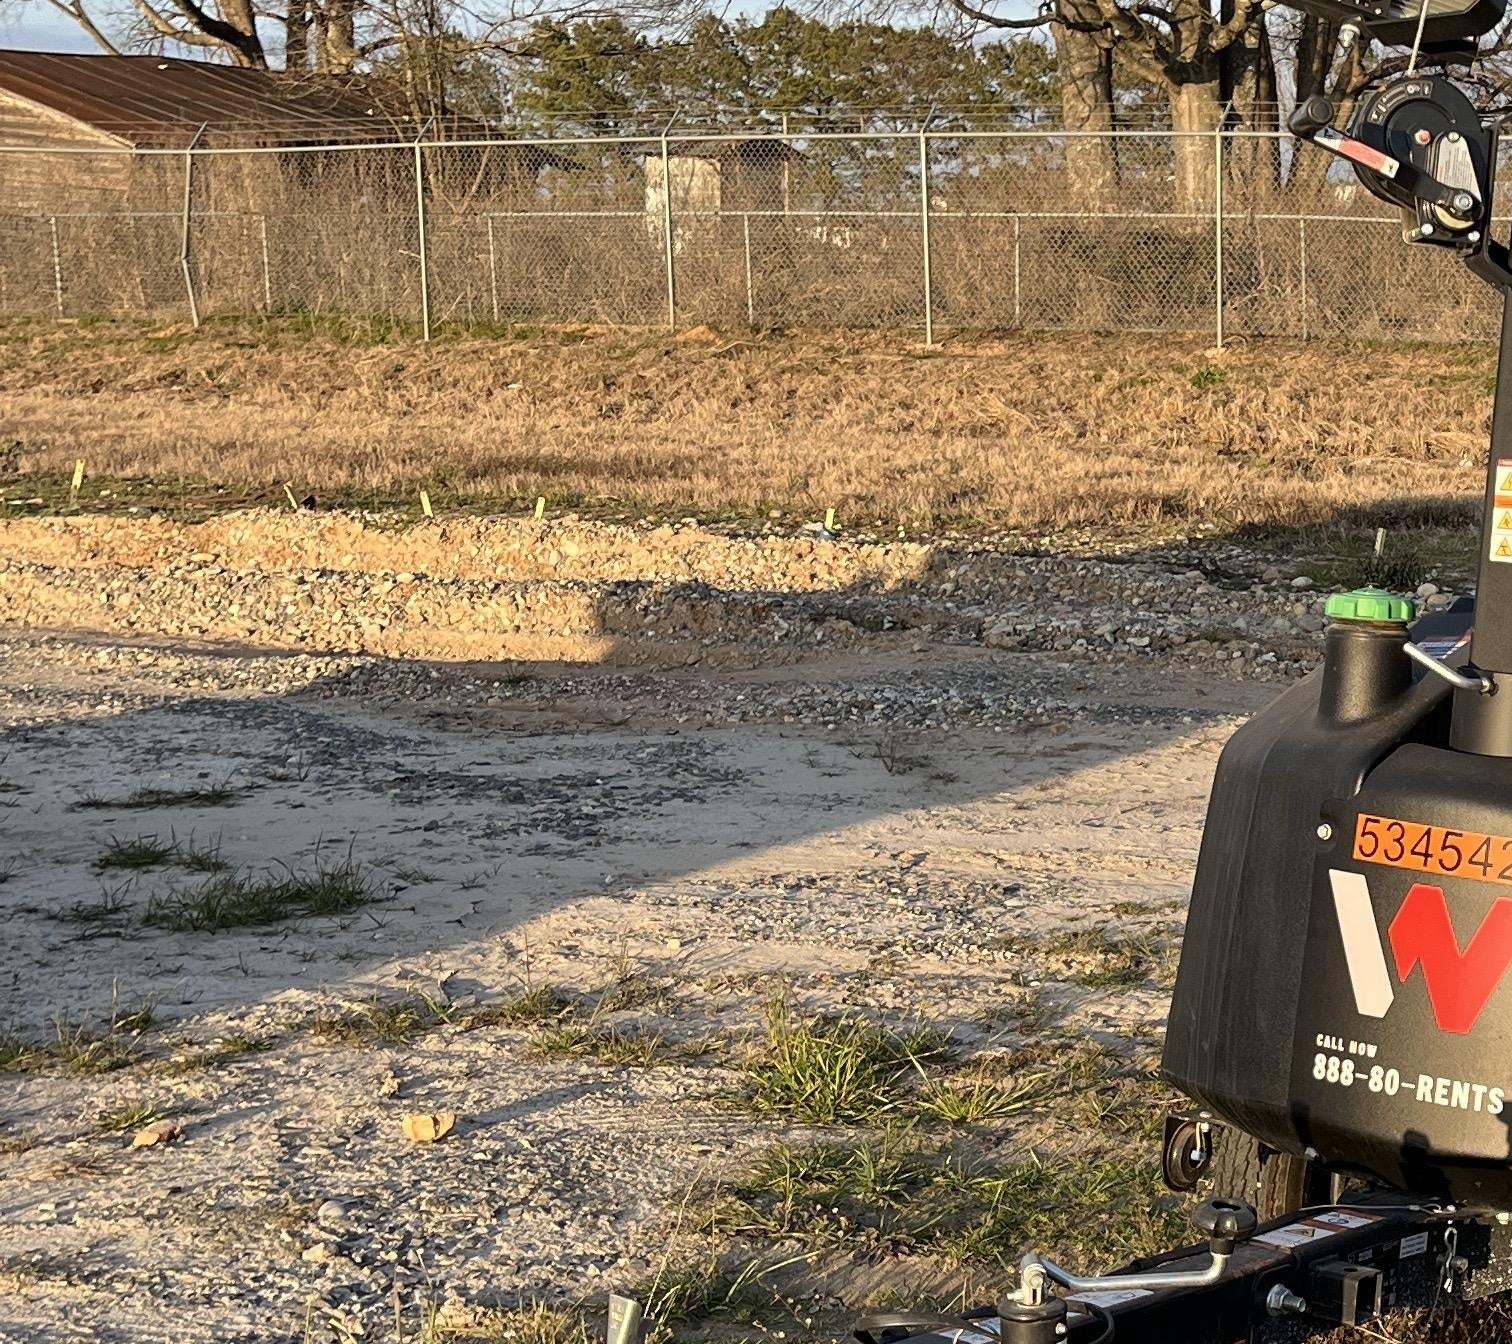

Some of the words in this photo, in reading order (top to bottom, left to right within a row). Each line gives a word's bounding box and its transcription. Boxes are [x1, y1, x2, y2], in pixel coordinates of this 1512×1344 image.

[1315, 1033, 1345, 1054] CALL
[1348, 1039, 1378, 1059] NOW
[1312, 1052, 1506, 1116] 888-80-RENTS
